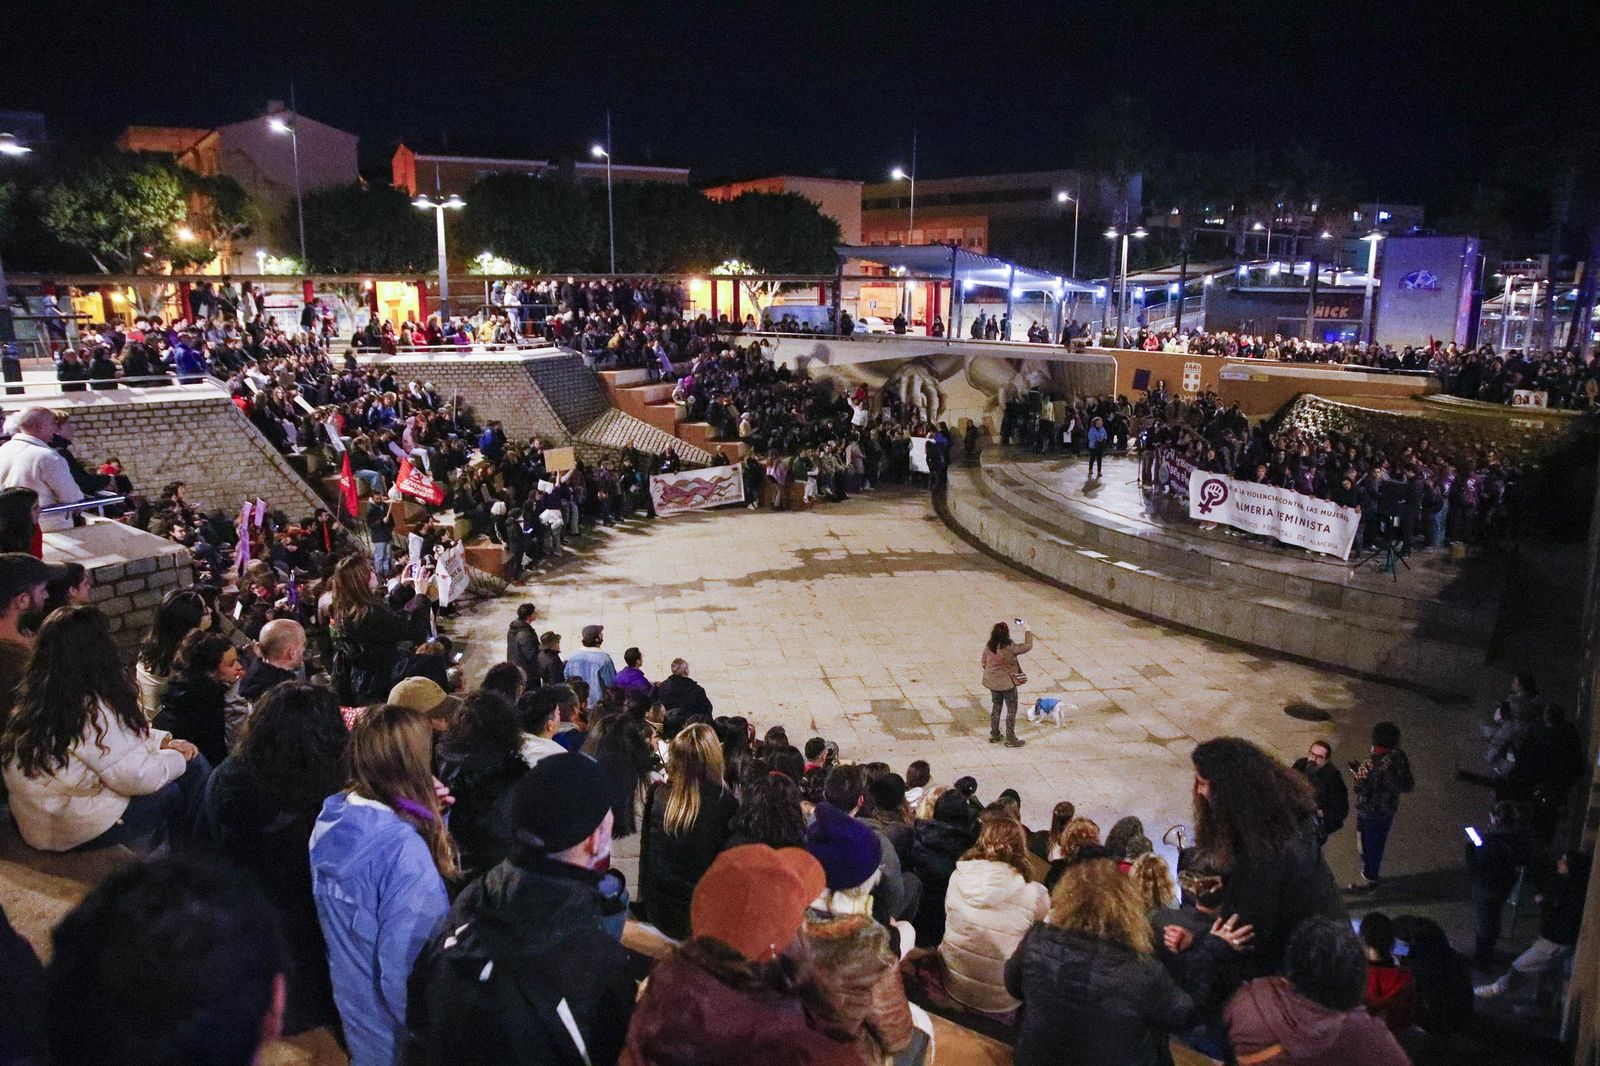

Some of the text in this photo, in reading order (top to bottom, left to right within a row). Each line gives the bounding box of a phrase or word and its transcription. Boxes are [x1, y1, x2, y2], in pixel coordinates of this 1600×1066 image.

[1235, 501, 1274, 517] ALMERÍA
[1246, 491, 1279, 502] VIOLENCIA
[1279, 497, 1304, 511] CONTRA
[1306, 506, 1318, 514] LAS
